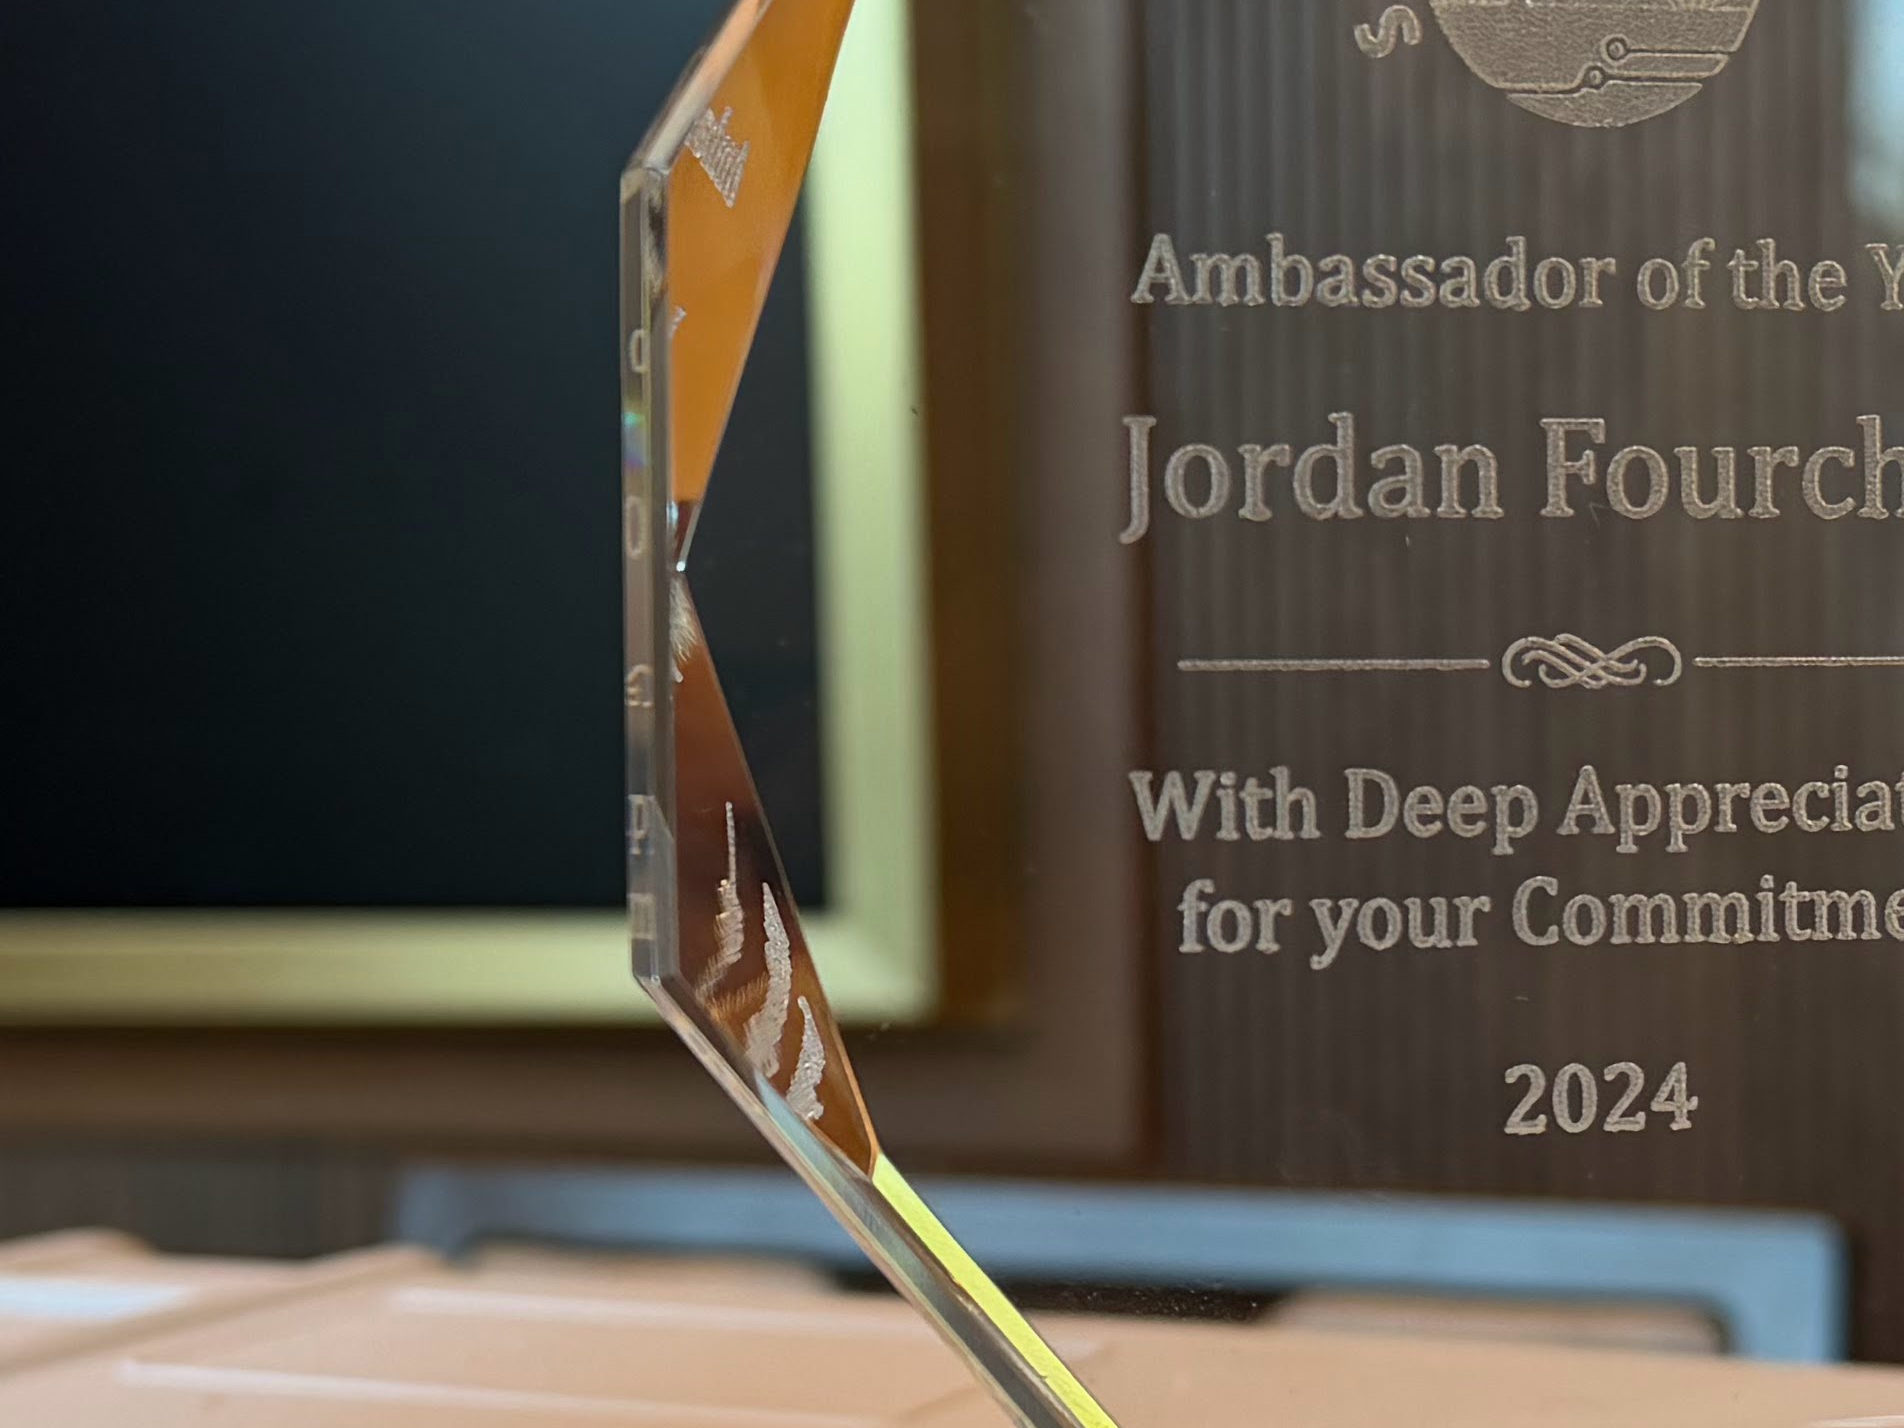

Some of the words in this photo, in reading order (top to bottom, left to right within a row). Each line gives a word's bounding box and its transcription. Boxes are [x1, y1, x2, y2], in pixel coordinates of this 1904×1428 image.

[1130, 232, 1616, 310] Ambassador
[1637, 236, 1716, 311] of
[1729, 237, 1847, 312] the
[1120, 410, 1503, 544] Jordan
[1129, 765, 1322, 844] With
[1344, 767, 1540, 855] Deep
[1177, 878, 1294, 954] for
[1309, 890, 1492, 971] your
[1504, 1058, 1699, 1136] 2024
